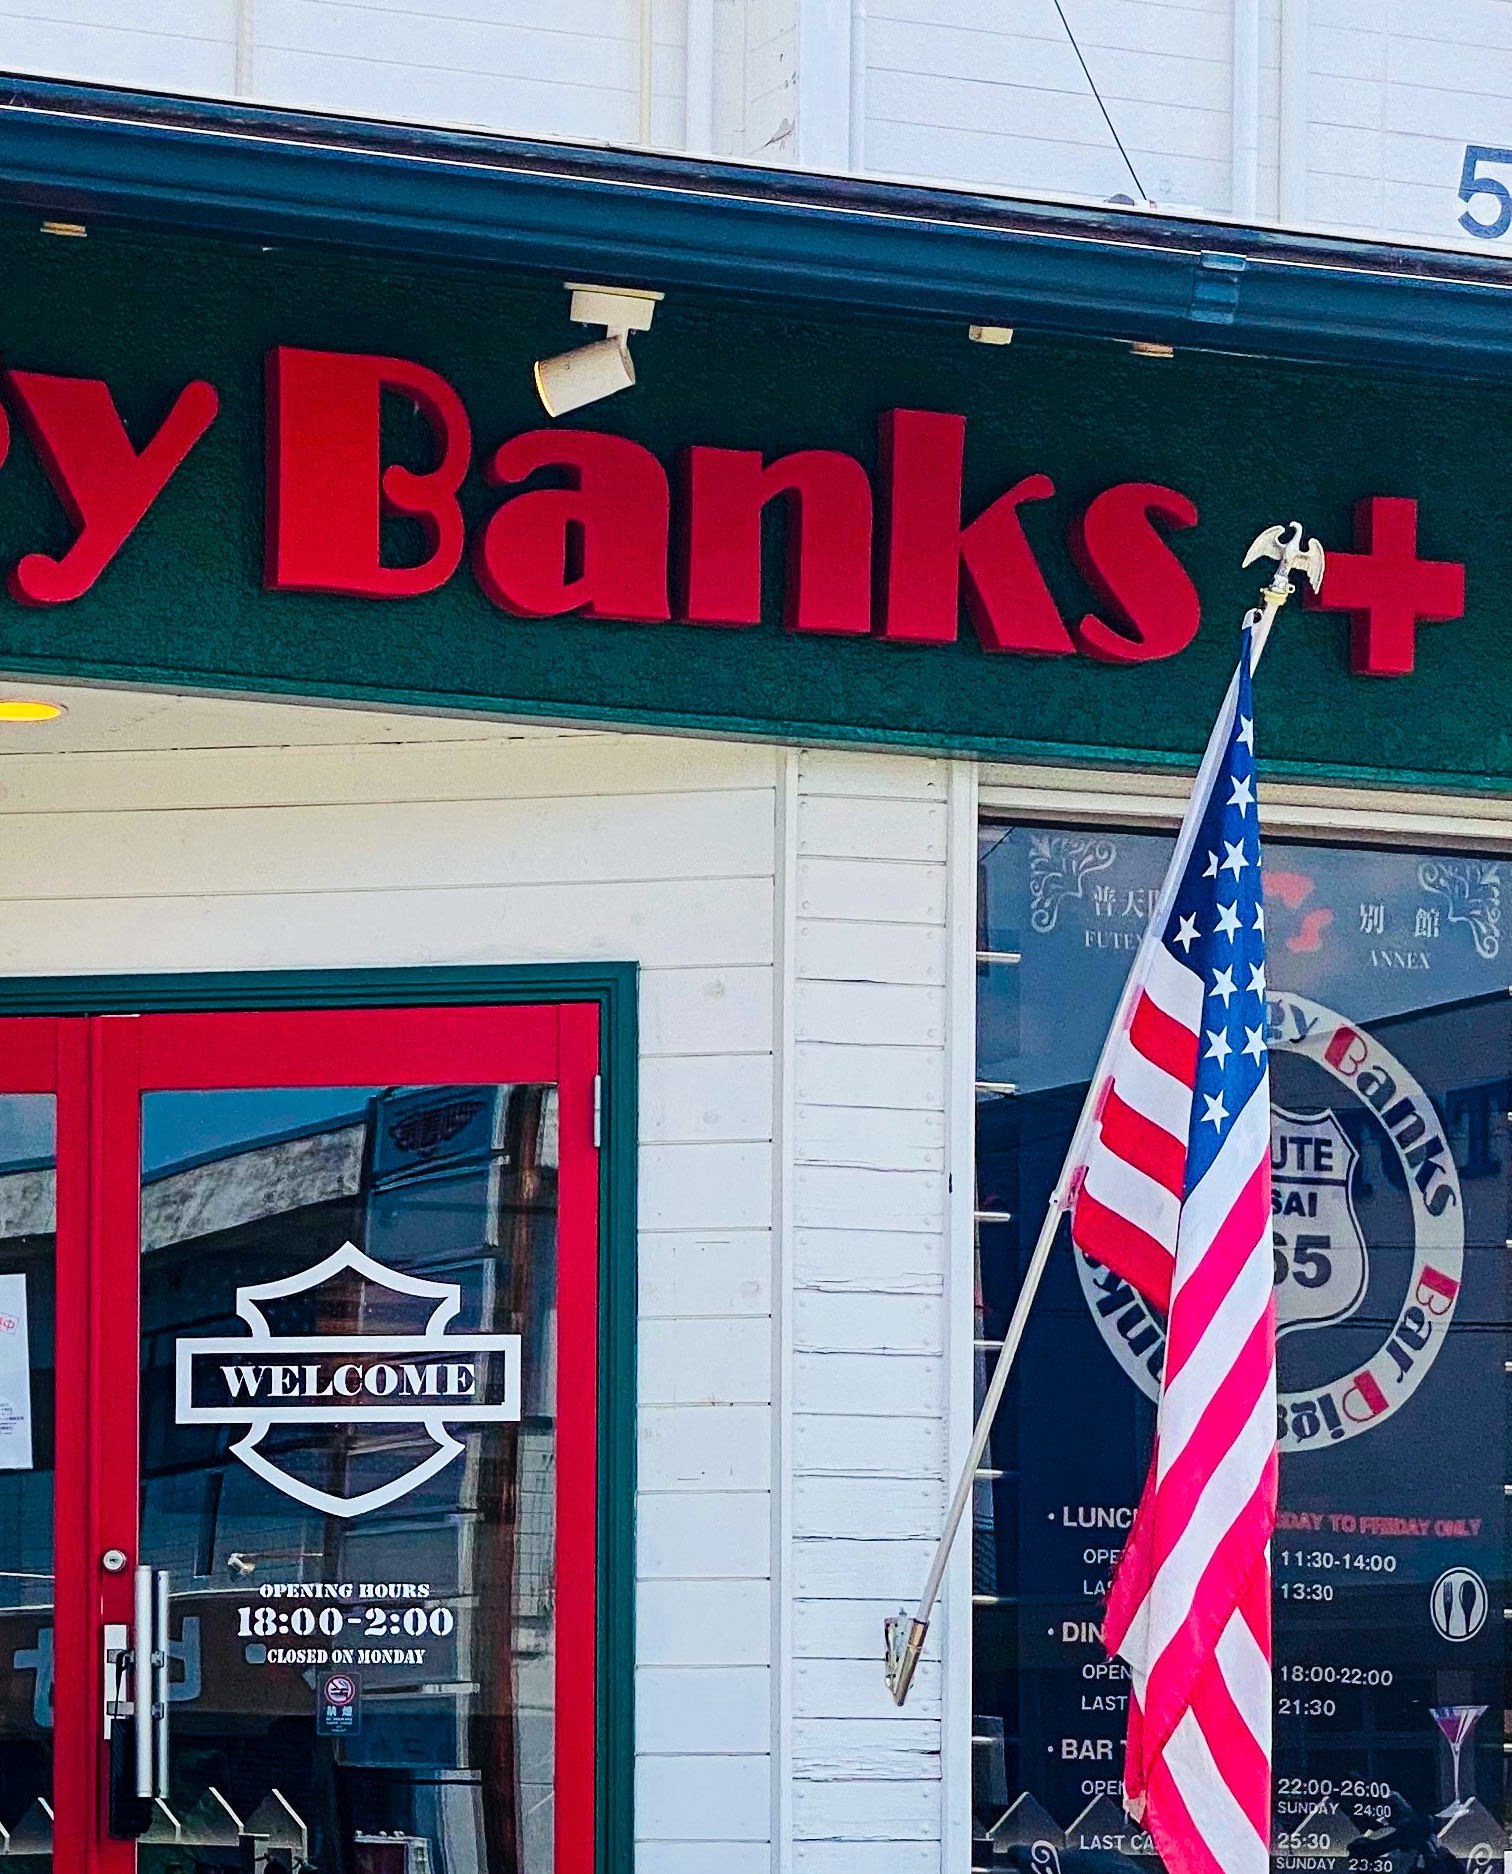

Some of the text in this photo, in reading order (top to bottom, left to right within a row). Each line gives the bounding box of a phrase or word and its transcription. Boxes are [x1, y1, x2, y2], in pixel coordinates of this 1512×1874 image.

[263, 346, 1200, 664] Banks
[1370, 950, 1431, 970] ANNEX
[1324, 1024, 1456, 1217] Banks
[1272, 1136, 1333, 1172] UTE
[1272, 1188, 1317, 1217] SAI
[1386, 1265, 1461, 1383] Bar
[220, 1363, 476, 1399] WELCOME
[1063, 1506, 1138, 1528] LUNC
[1331, 1514, 1356, 1534] TO
[1360, 1516, 1430, 1537] FRIDAY
[1083, 1549, 1397, 1572] OPE 11:30-14:00
[259, 1583, 431, 1598] OPENING HOURS
[1083, 1580, 1334, 1601] LA 13:30
[237, 1606, 454, 1637] 18:00-2:00
[1062, 1622, 1106, 1643] DIN
[267, 1648, 426, 1665] CLOSED ON MONDAY
[1281, 1665, 1393, 1686] 18:00-22:00
[1082, 1696, 1336, 1716] LAST 21:30
[1061, 1738, 1113, 1760] BAR
[1277, 1778, 1390, 1799] 22:00-26:00
[1277, 1801, 1392, 1818] SUNDAY 24:00
[1080, 1832, 1330, 1850] LAST CA 25:30
[1276, 1857, 1393, 1873] SUNDAY 23:30
